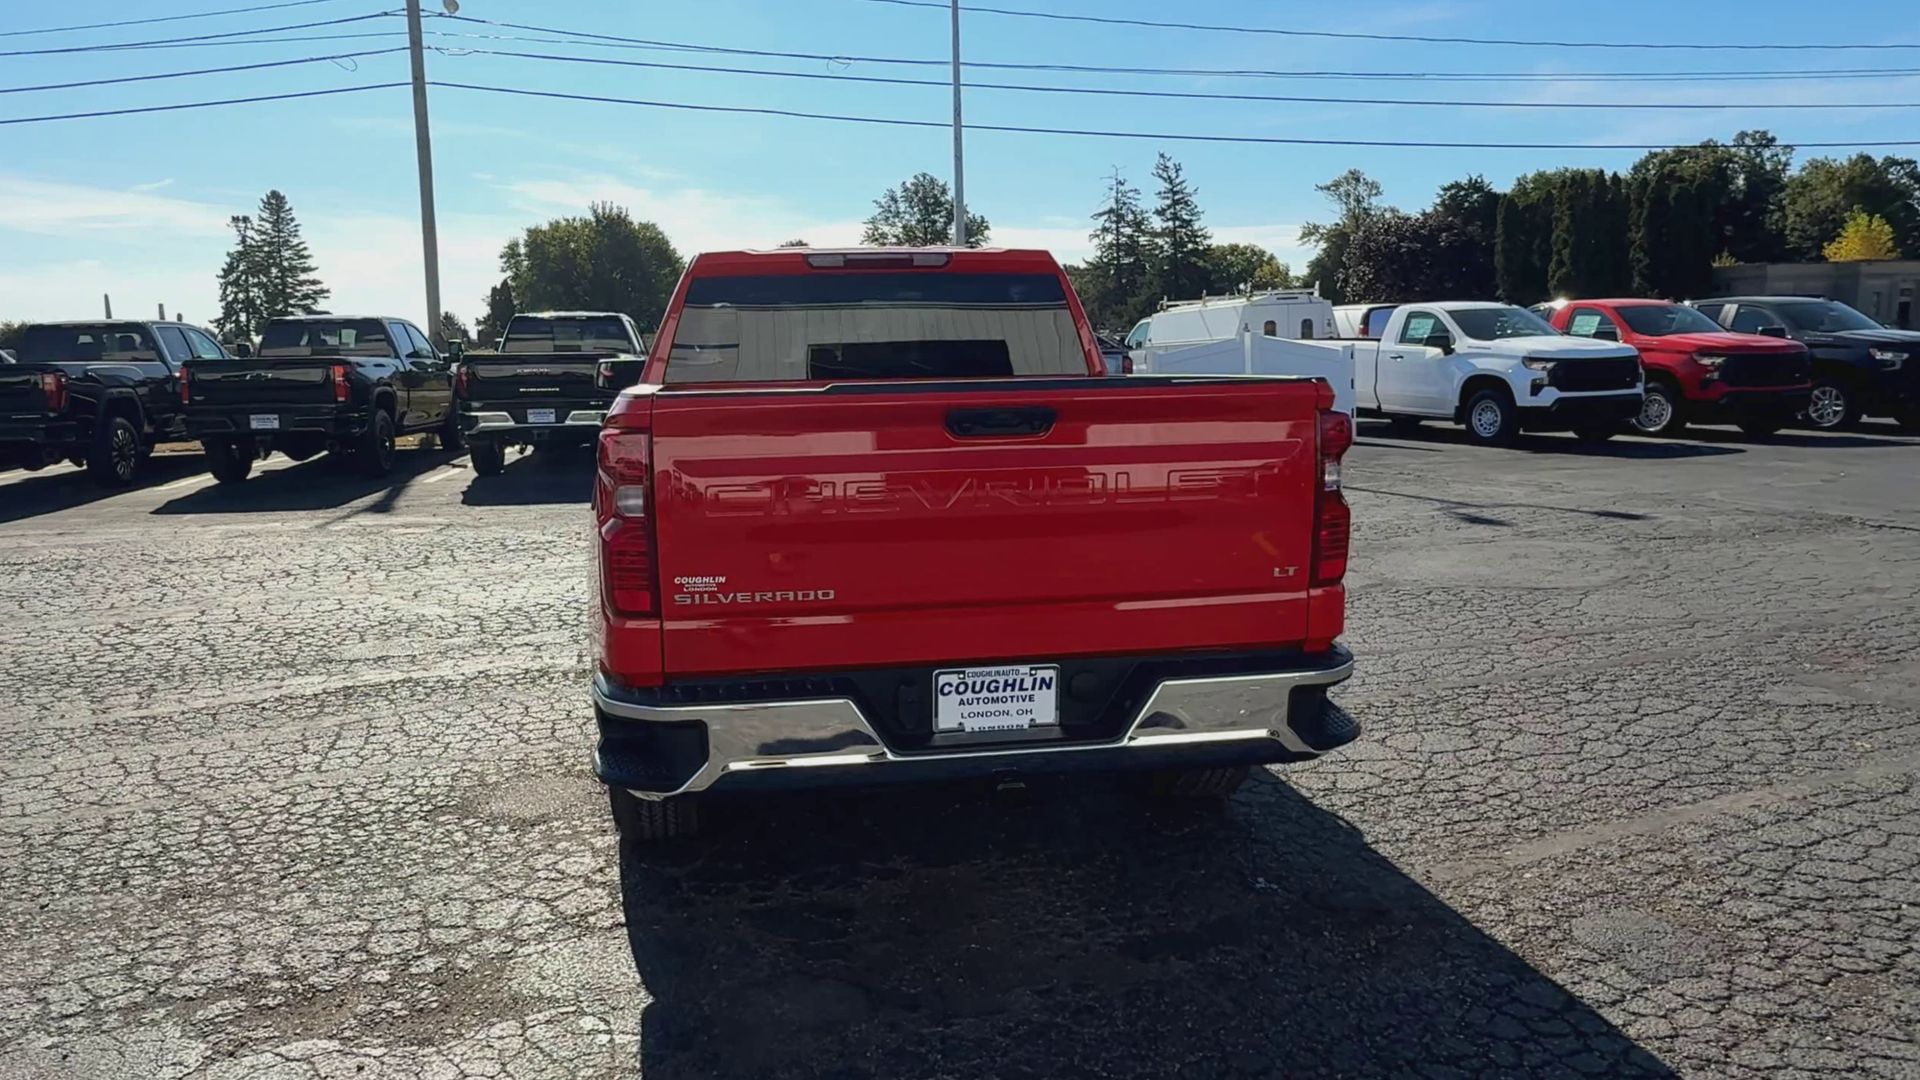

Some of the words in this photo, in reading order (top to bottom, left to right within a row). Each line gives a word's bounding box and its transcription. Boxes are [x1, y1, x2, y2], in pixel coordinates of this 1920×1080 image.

[1273, 566, 1299, 577] LT
[674, 576, 726, 584] COUGHLIN
[673, 589, 835, 605] SILVERADO
[939, 676, 1053, 696] COUGHLIN
[958, 693, 1036, 706] AUTOMOTIVE
[960, 709, 1013, 719] LONDON,
[1016, 708, 1033, 716] OH
